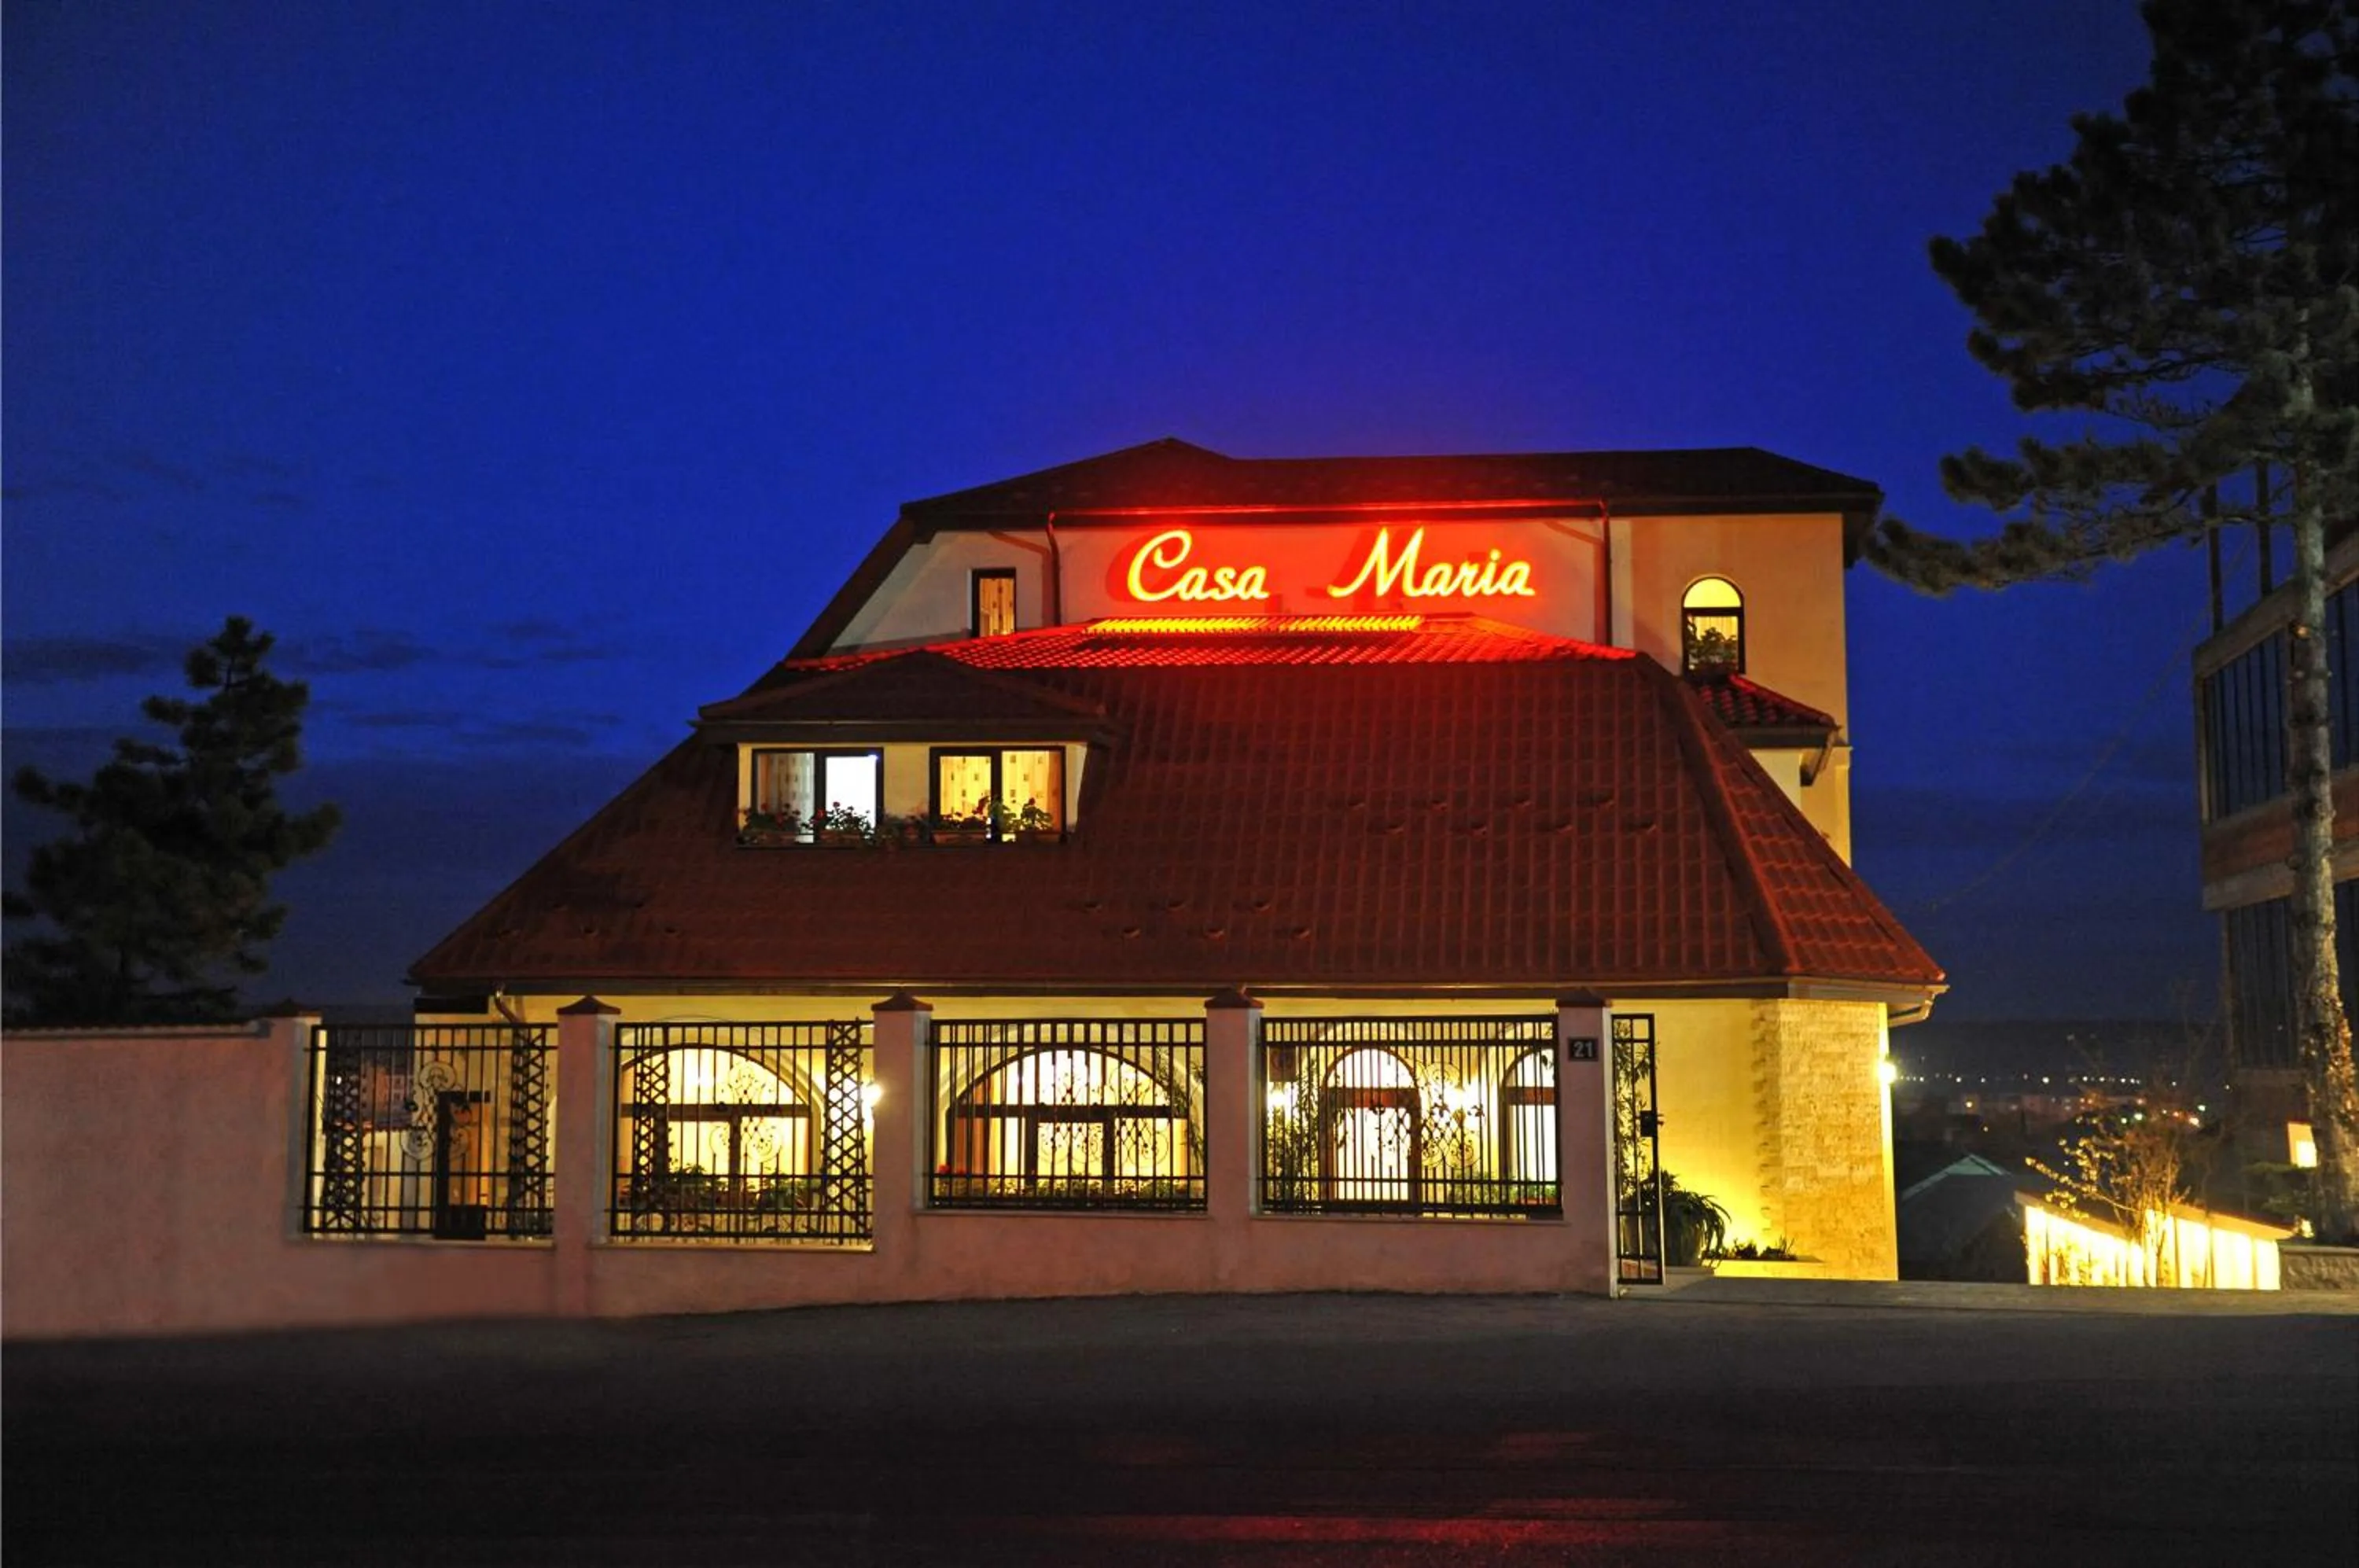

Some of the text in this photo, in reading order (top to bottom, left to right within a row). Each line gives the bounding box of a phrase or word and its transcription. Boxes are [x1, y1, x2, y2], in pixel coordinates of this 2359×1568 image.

[1126, 526, 1535, 602] Casa Maria
[1573, 1040, 1593, 1058] 21
